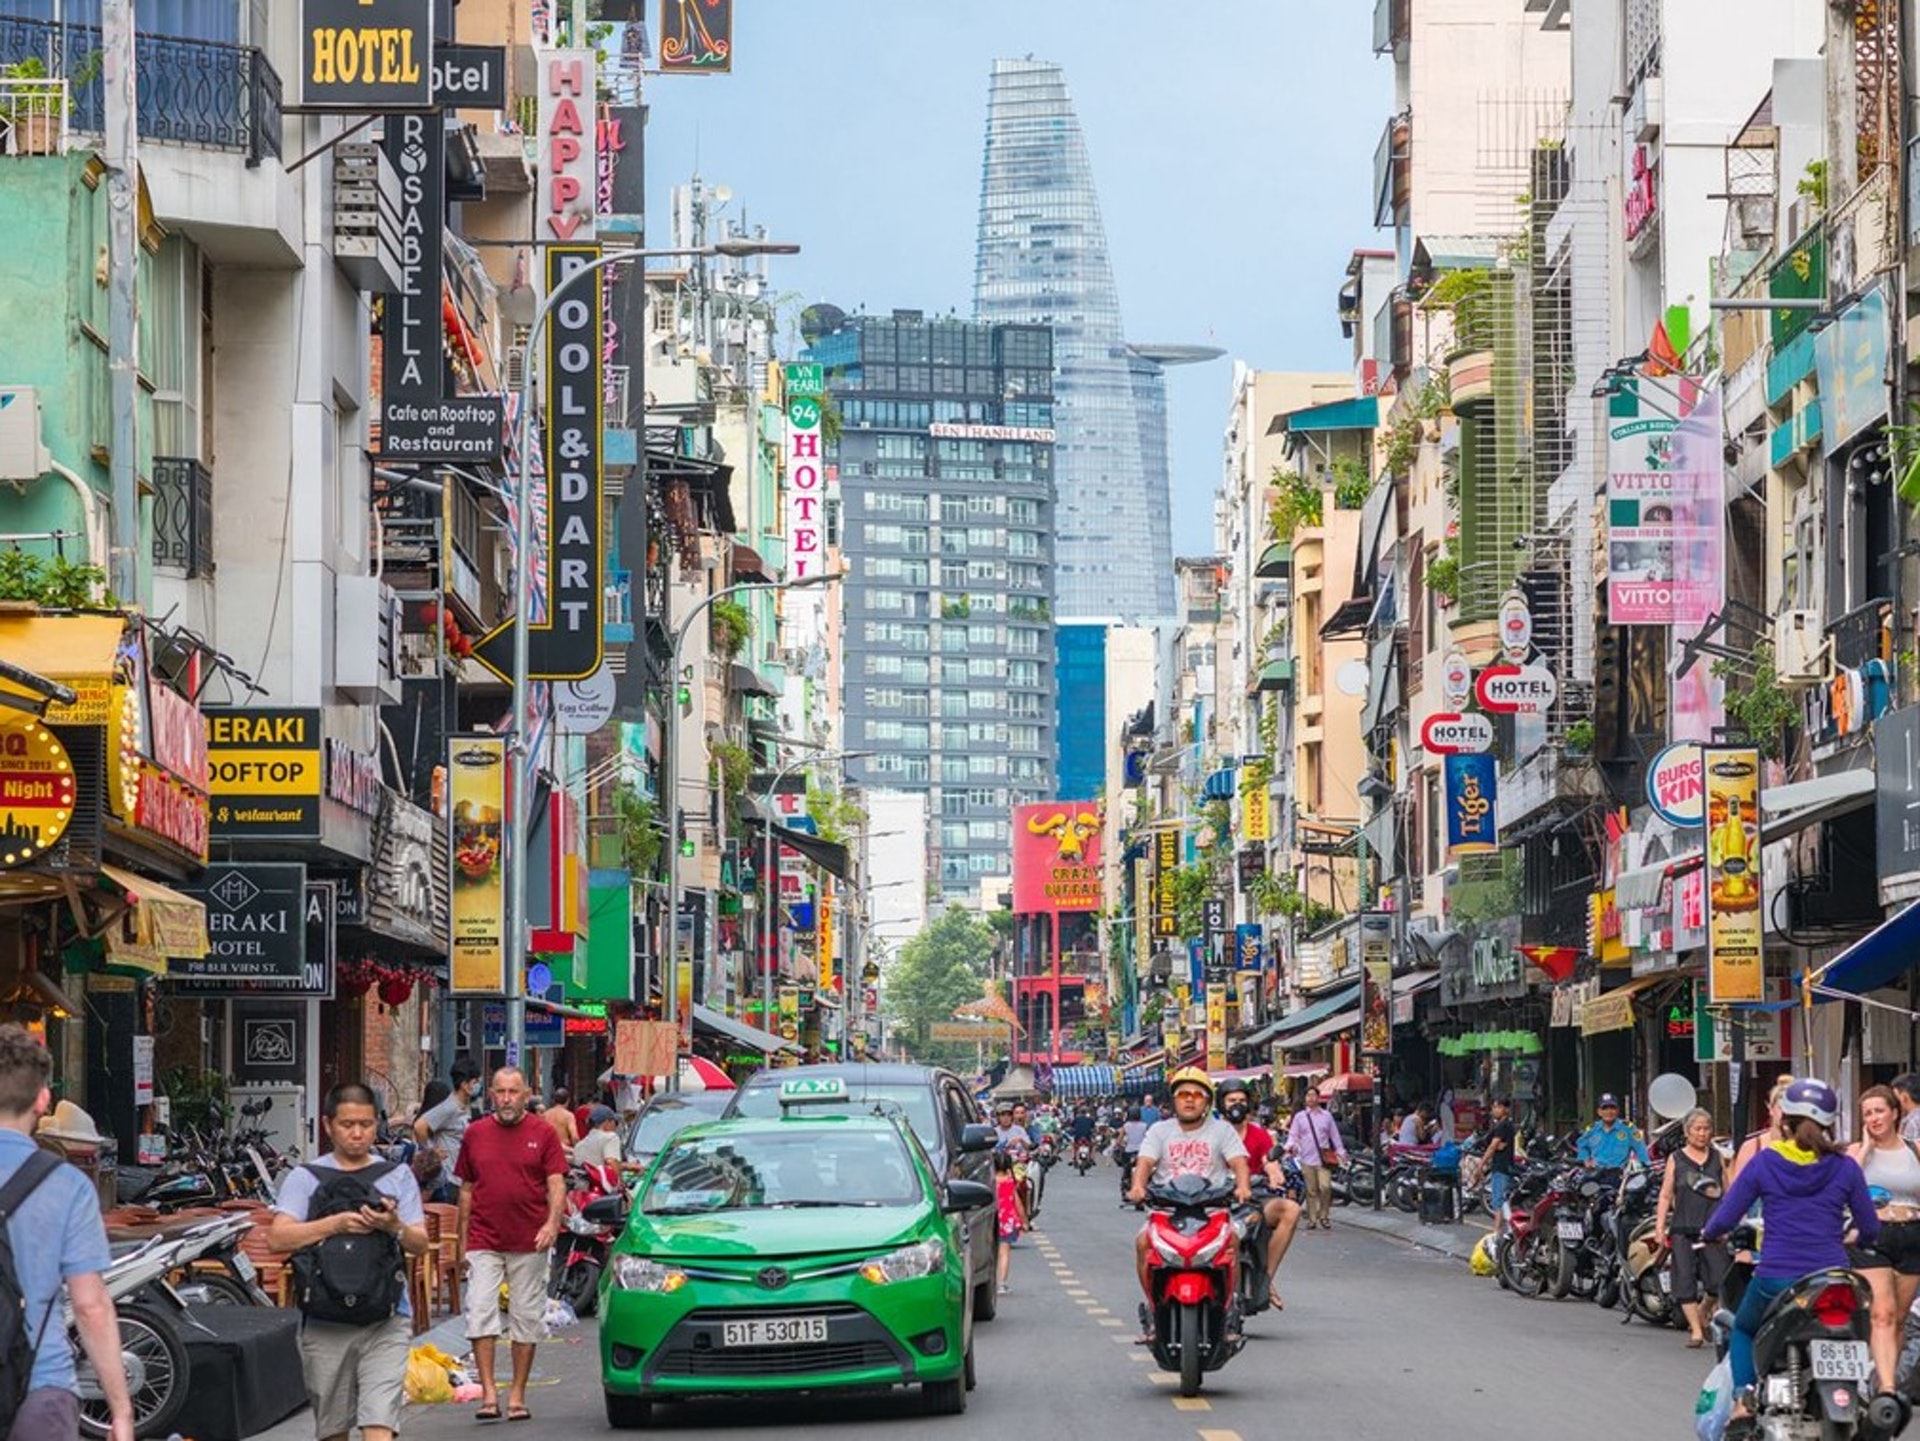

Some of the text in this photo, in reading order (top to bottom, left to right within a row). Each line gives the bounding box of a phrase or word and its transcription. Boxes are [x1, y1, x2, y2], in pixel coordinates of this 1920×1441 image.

[313, 28, 419, 84] HOTEL
[547, 59, 583, 240] HAPPY
[788, 379, 819, 392] PEARL
[388, 404, 496, 427] Cafe on Rooftop
[792, 405, 816, 423] 94
[428, 424, 456, 437] and
[389, 435, 494, 452] Restaurant
[1490, 680, 1552, 695] HOTEL
[1433, 726, 1488, 739] HOTEL
[4, 780, 54, 800] Night
[1457, 773, 1490, 837] Tiger
[217, 806, 304, 824] & restaurant
[207, 910, 288, 934] ERAKI
[206, 964, 227, 973] BUI
[231, 964, 259, 973] VIEN
[784, 1080, 839, 1094] TAXI
[727, 1322, 759, 1343] 51F
